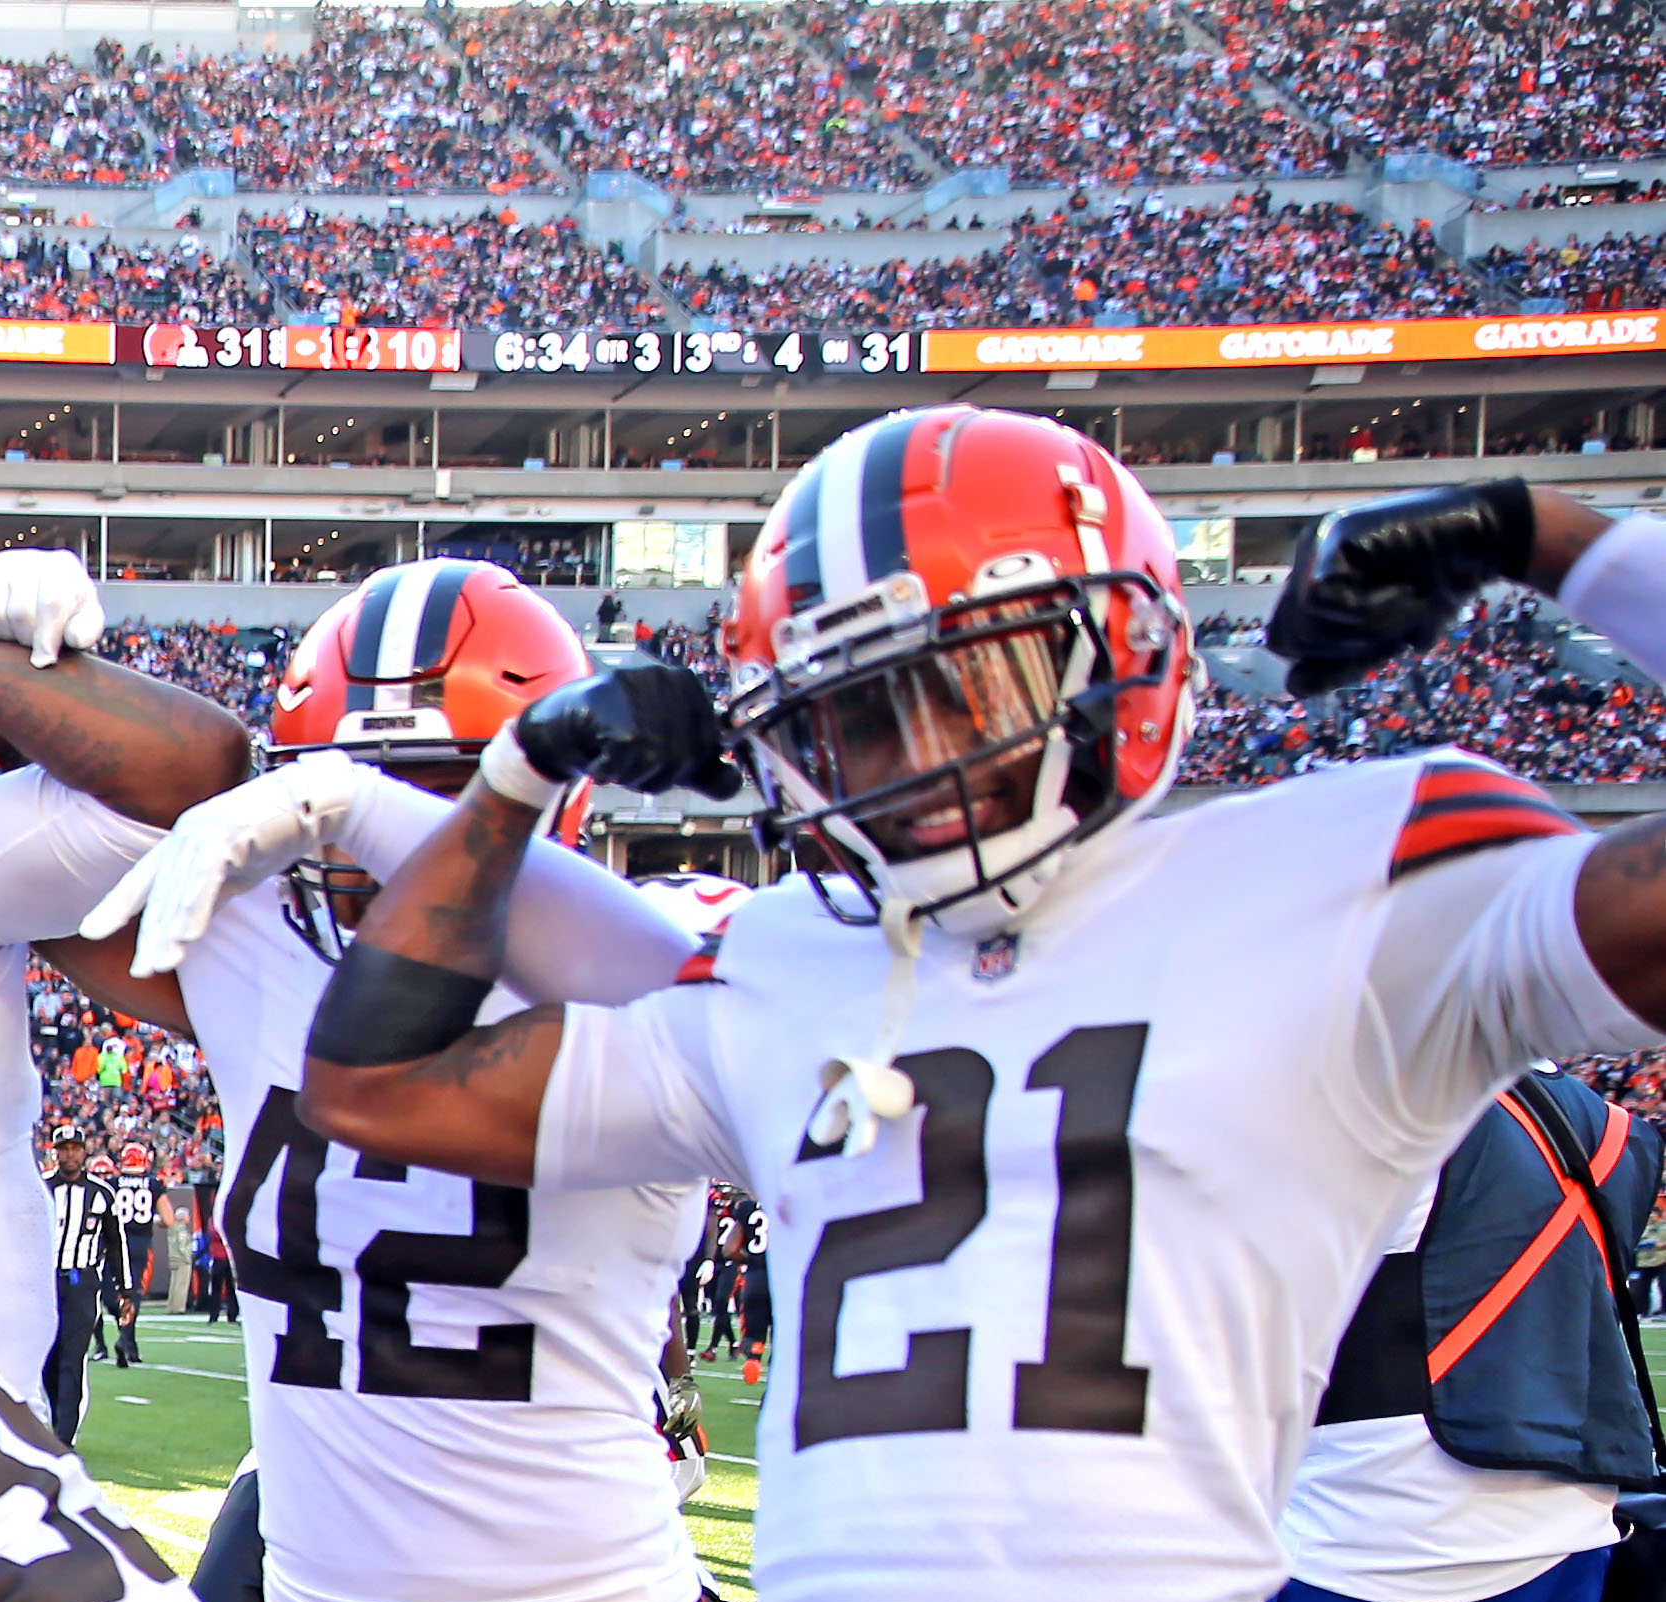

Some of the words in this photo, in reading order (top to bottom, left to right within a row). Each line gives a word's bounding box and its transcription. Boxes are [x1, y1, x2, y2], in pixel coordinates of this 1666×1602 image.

[216, 326, 263, 367] 31
[388, 330, 437, 370] 10
[494, 331, 592, 373] 6:34
[633, 331, 662, 373] 3
[773, 331, 805, 373] 4
[861, 331, 911, 373] 31
[976, 336, 1145, 364] GATORADE
[1219, 328, 1394, 360] GATORADE
[1474, 317, 1659, 351] GATORADE
[117, 1176, 150, 1189] SAMPLE
[115, 1188, 154, 1225] 89
[225, 1085, 535, 1402] 42
[795, 1021, 1152, 1454] 21
